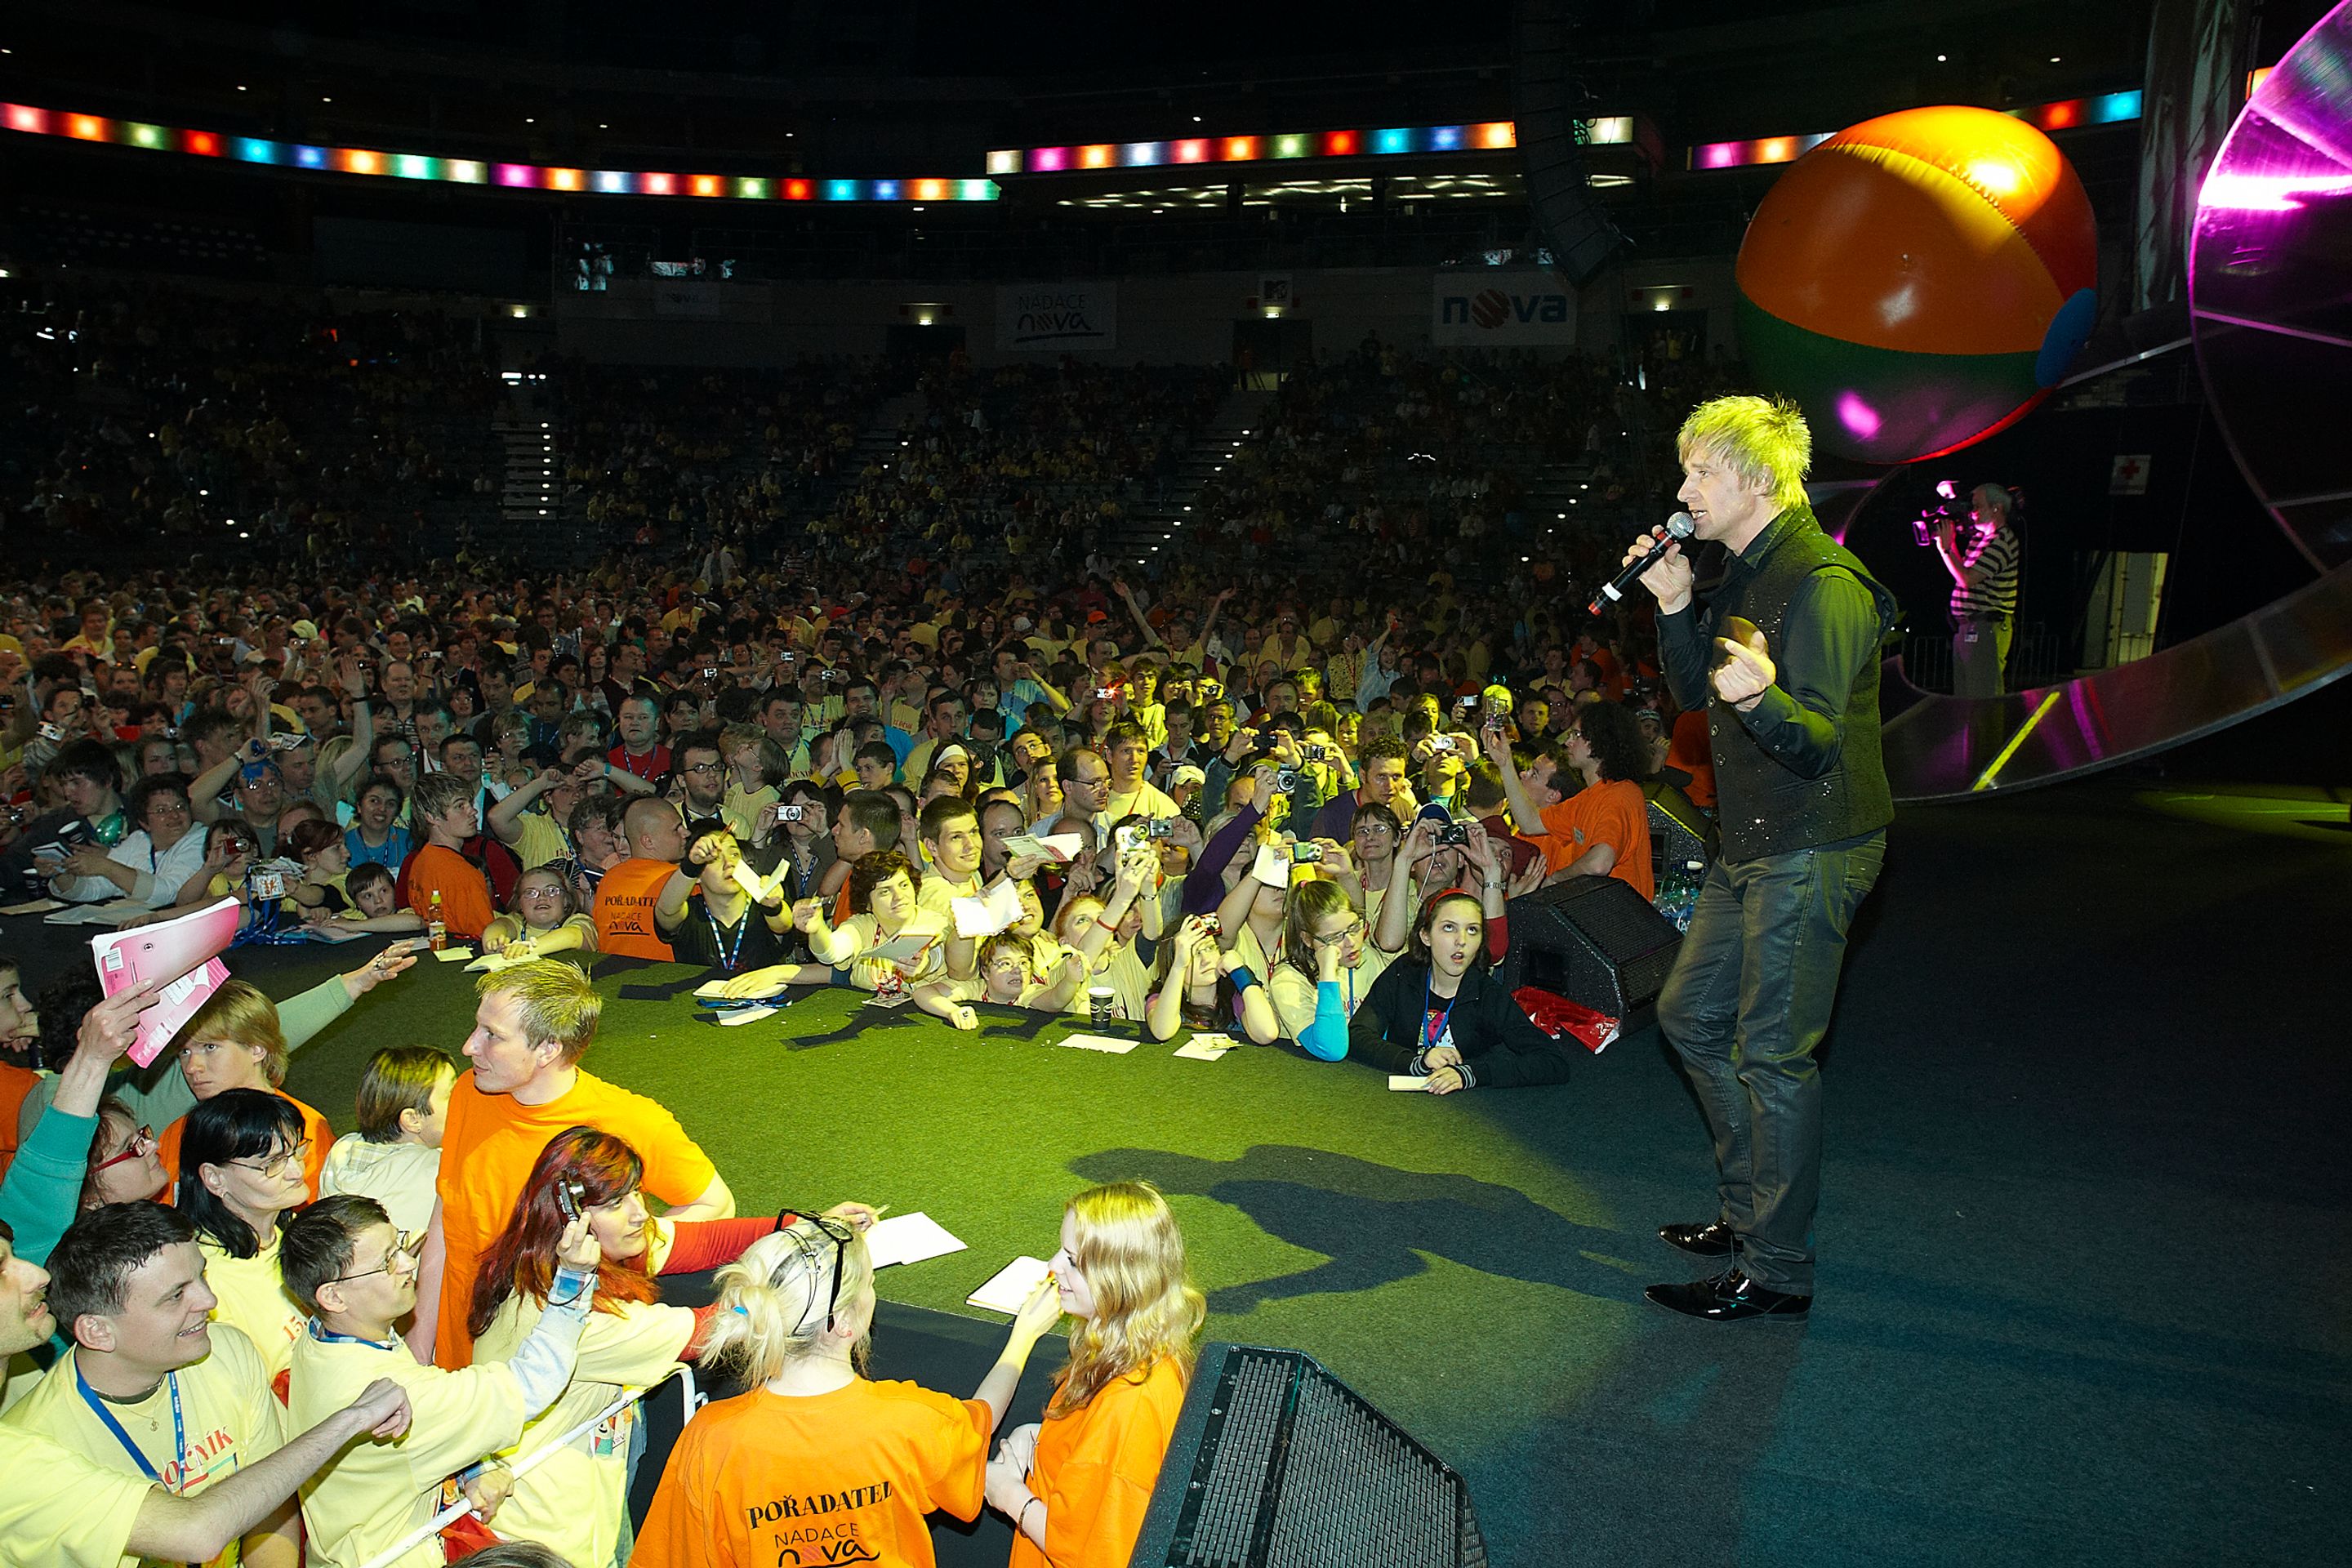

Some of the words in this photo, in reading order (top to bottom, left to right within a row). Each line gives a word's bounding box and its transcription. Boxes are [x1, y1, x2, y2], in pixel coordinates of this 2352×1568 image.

[1019, 294, 1086, 310] NADACE
[1443, 288, 1567, 328] nova
[604, 895, 657, 906] POŘADATE
[746, 1481, 893, 1530] POŘADATEL
[774, 1522, 860, 1548] NADACE
